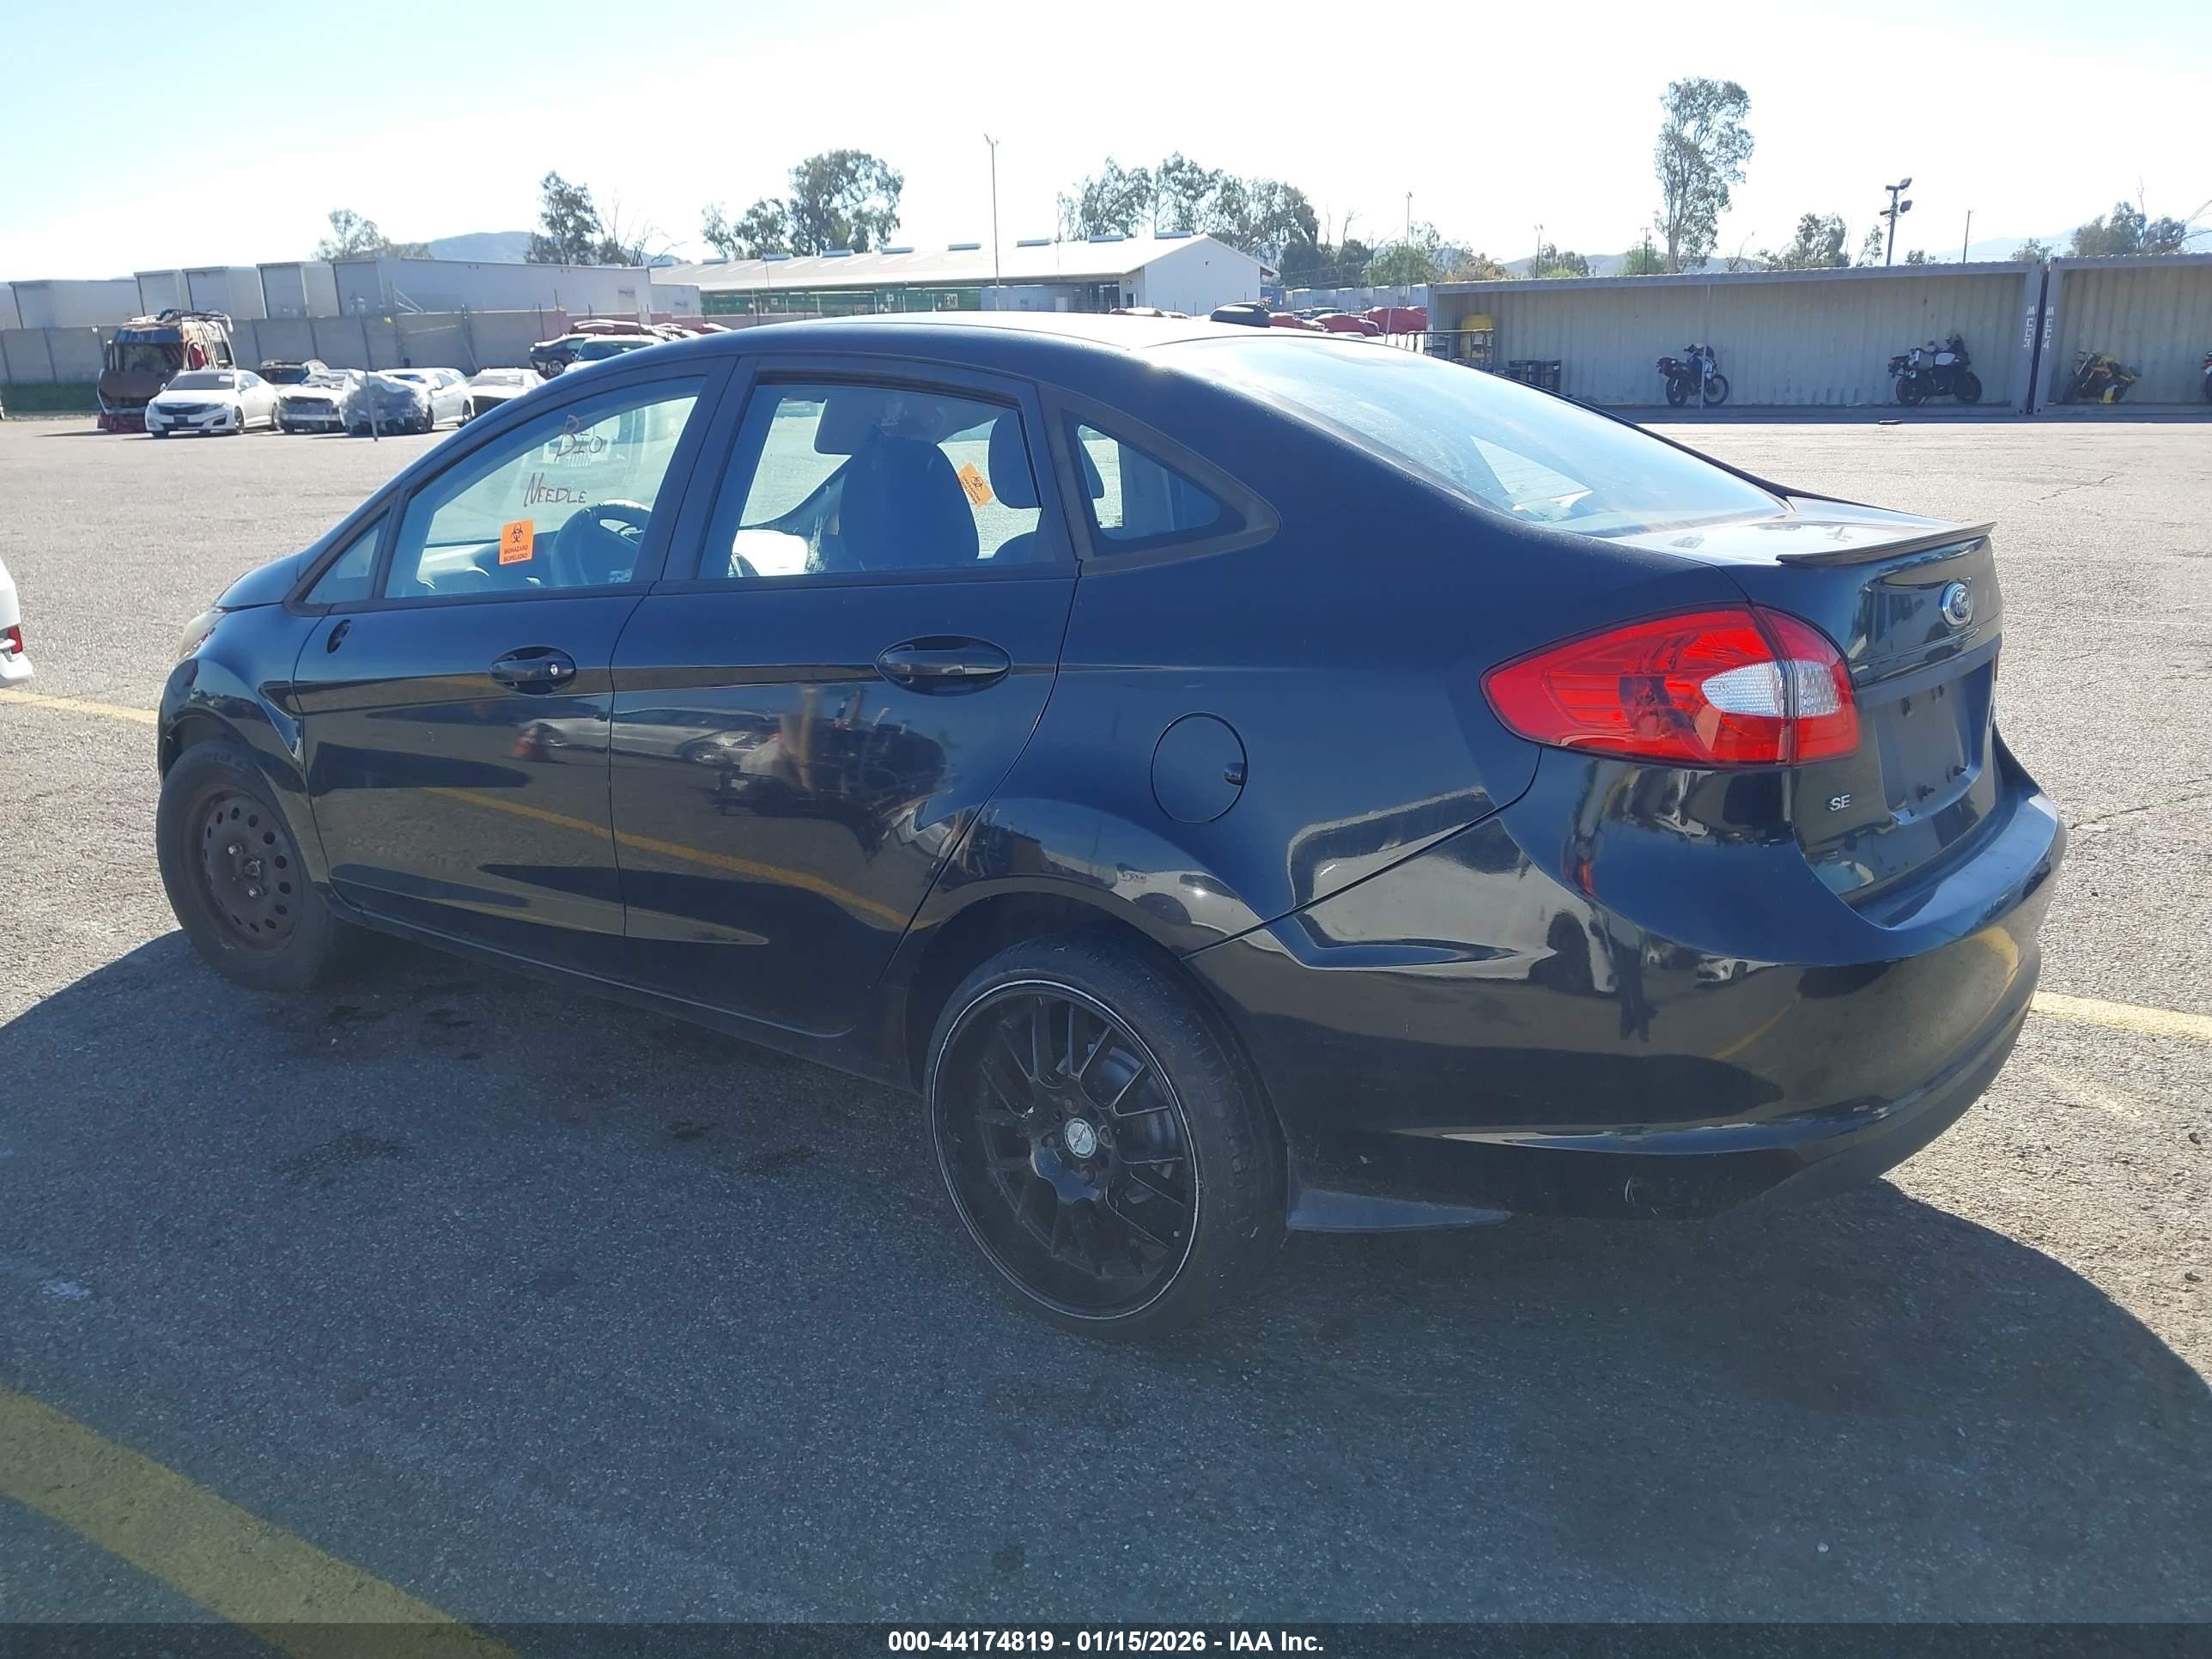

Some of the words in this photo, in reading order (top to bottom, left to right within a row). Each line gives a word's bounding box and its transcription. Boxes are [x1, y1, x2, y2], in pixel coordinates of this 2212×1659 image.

[2023, 305, 2035, 348] MCC3
[2043, 306, 2054, 349] MCC4
[523, 471, 587, 507] NEEDLE
[1828, 793, 1851, 811] SE
